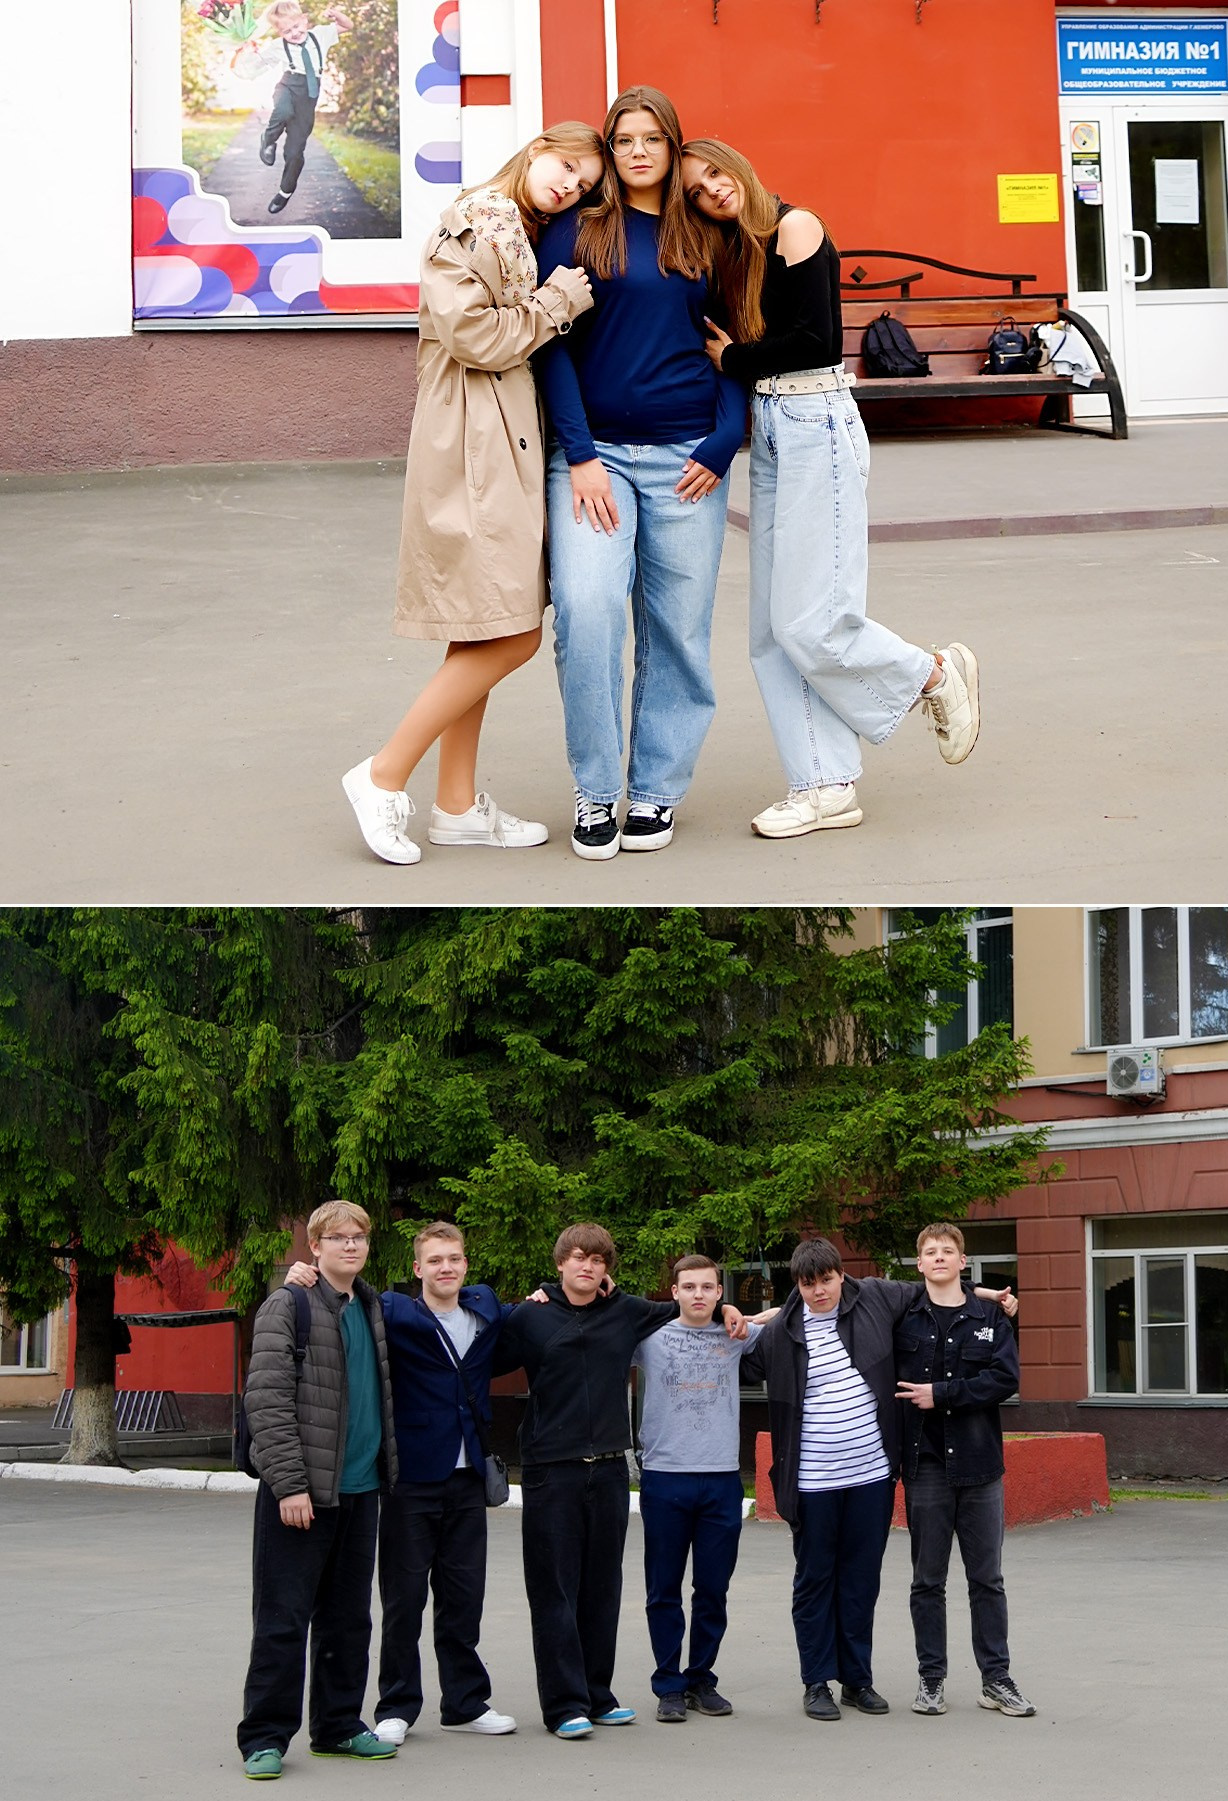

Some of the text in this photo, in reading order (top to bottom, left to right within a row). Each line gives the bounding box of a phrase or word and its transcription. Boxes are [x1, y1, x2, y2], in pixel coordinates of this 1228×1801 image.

[1067, 41, 1220, 60] ГИМНАЗИЯ №1
[1081, 67, 1207, 75] МУНИЦИПАЛЬНОЕ БЮДЖЕТНОЕ
[1064, 80, 1226, 88] ОБЩЕОБРАЗОВАТЕЛЬНОЕ УЧРЕЖДЕНИЕ
